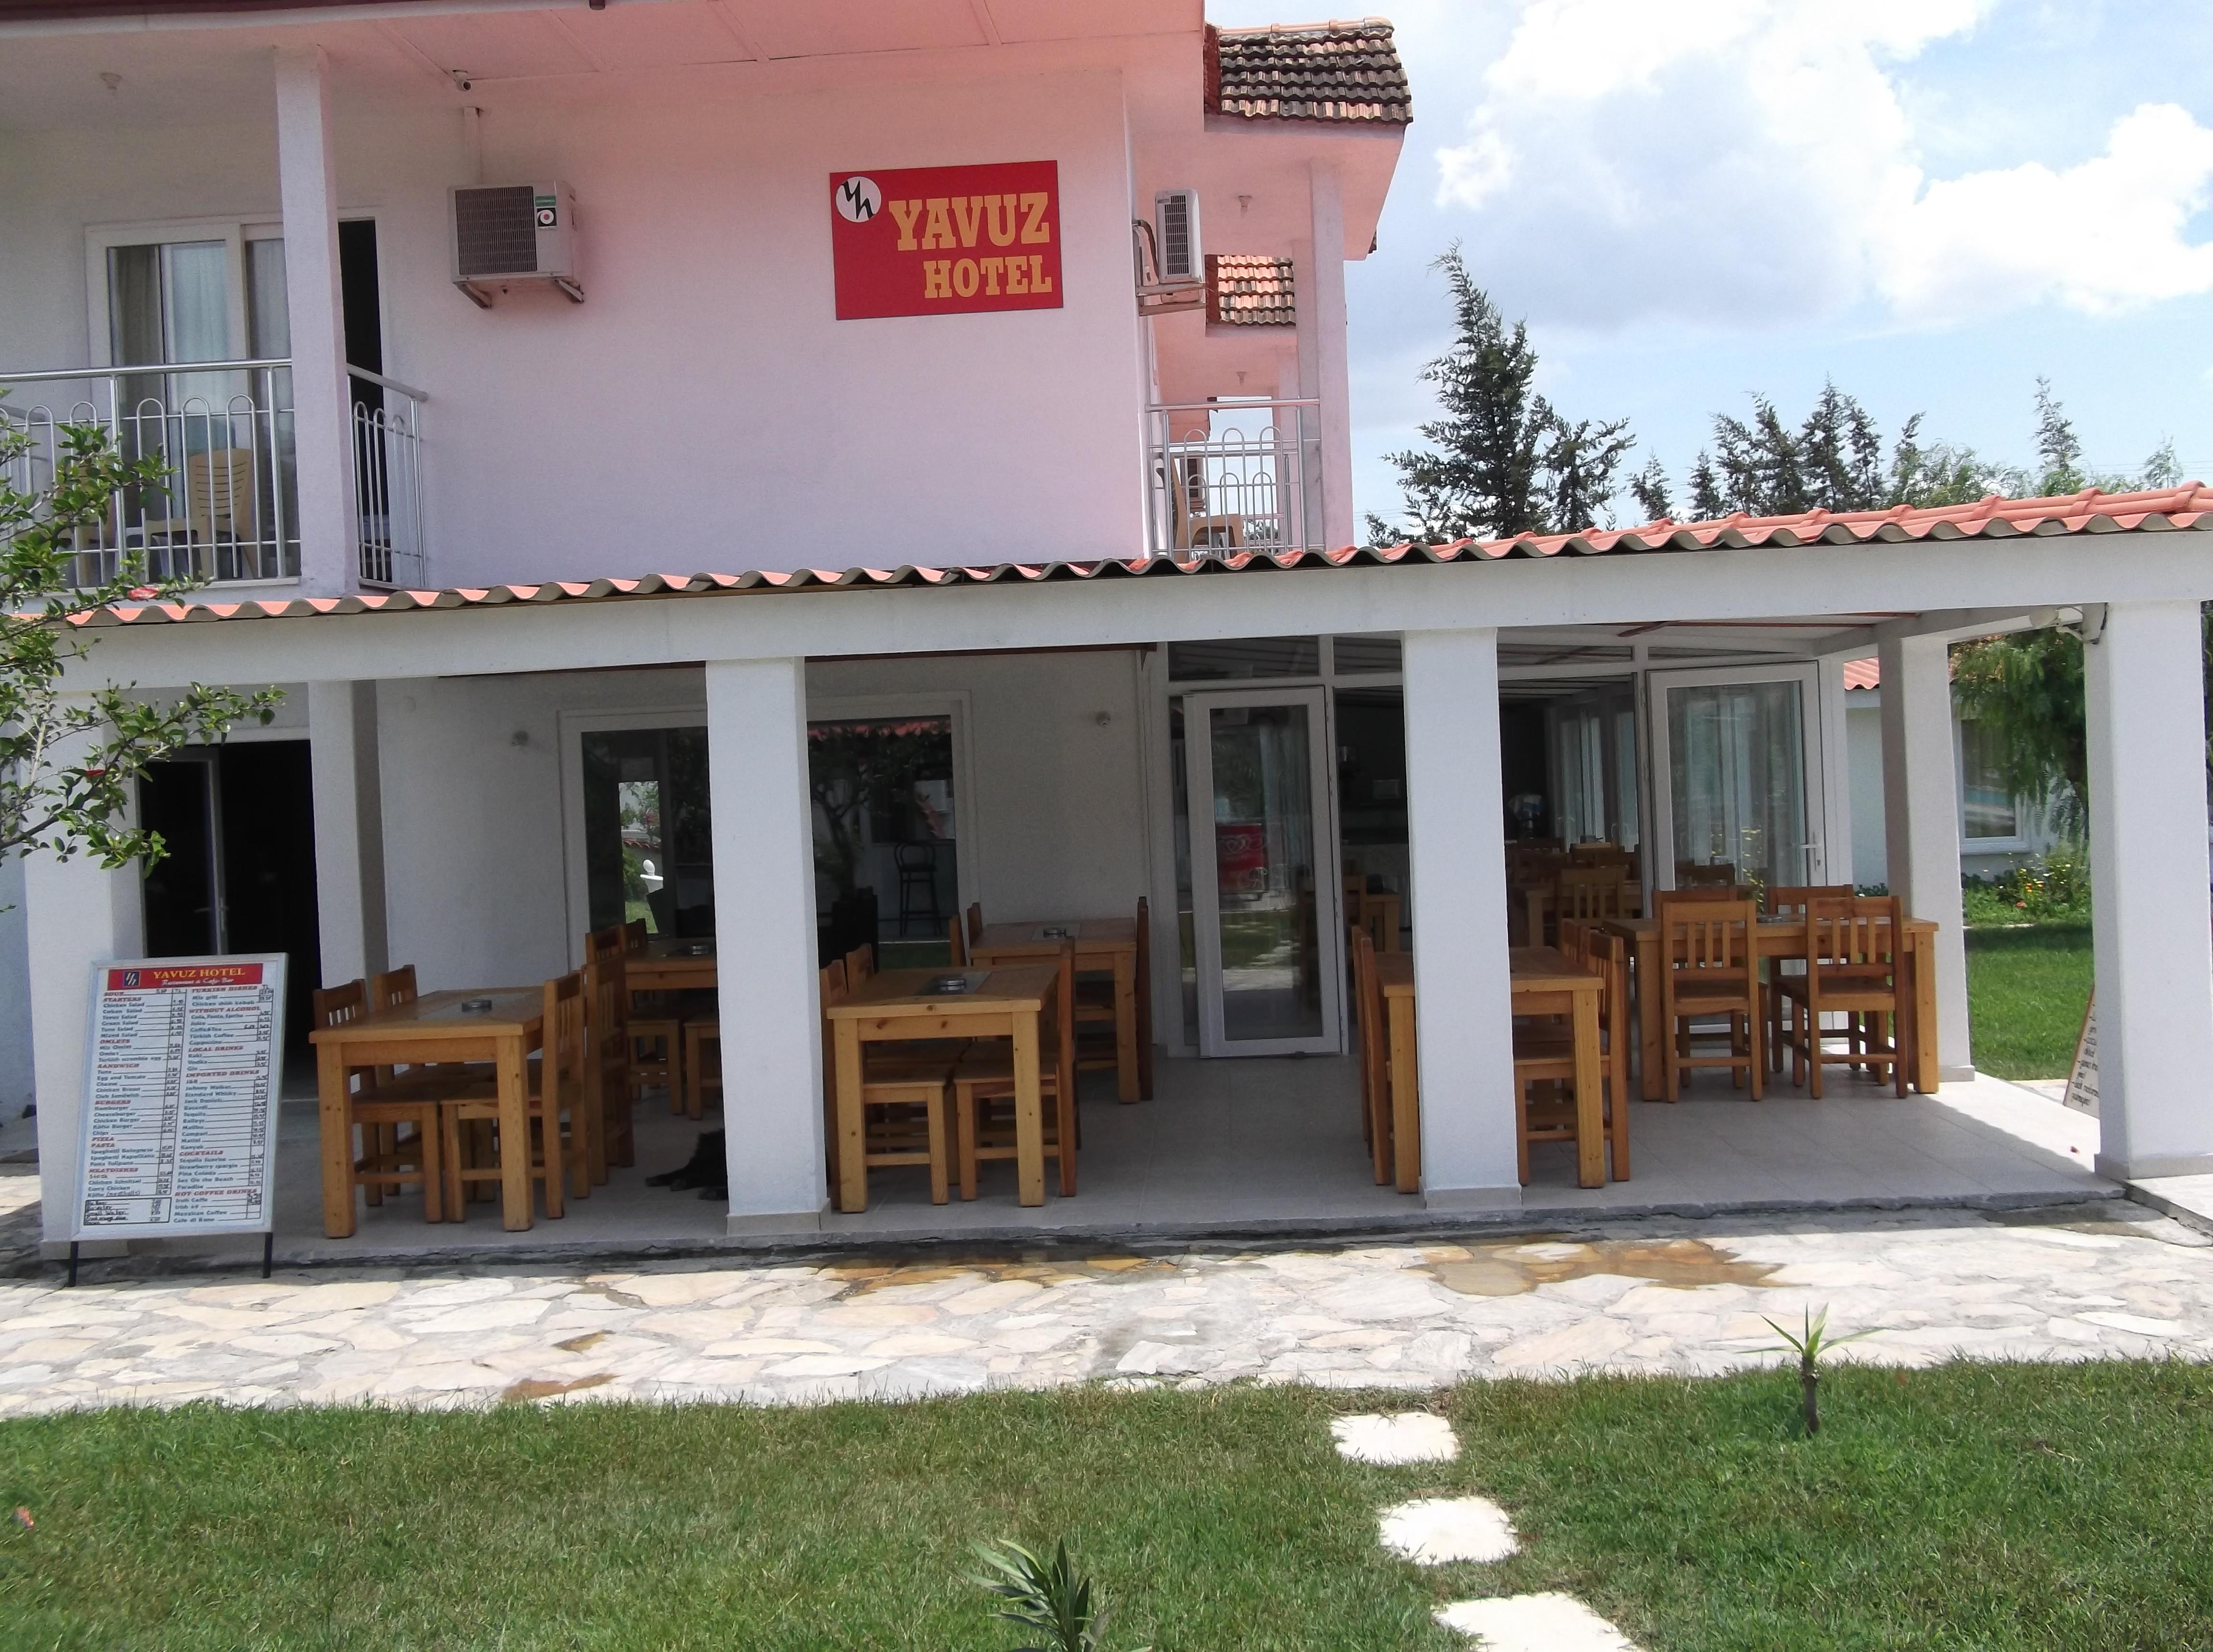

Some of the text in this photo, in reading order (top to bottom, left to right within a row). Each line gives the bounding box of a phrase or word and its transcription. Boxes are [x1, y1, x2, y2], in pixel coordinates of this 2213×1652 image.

[888, 192, 1050, 251] YAVUZ
[924, 255, 1052, 298] HOTEL
[154, 968, 245, 979] YAVUZ HOTEL
